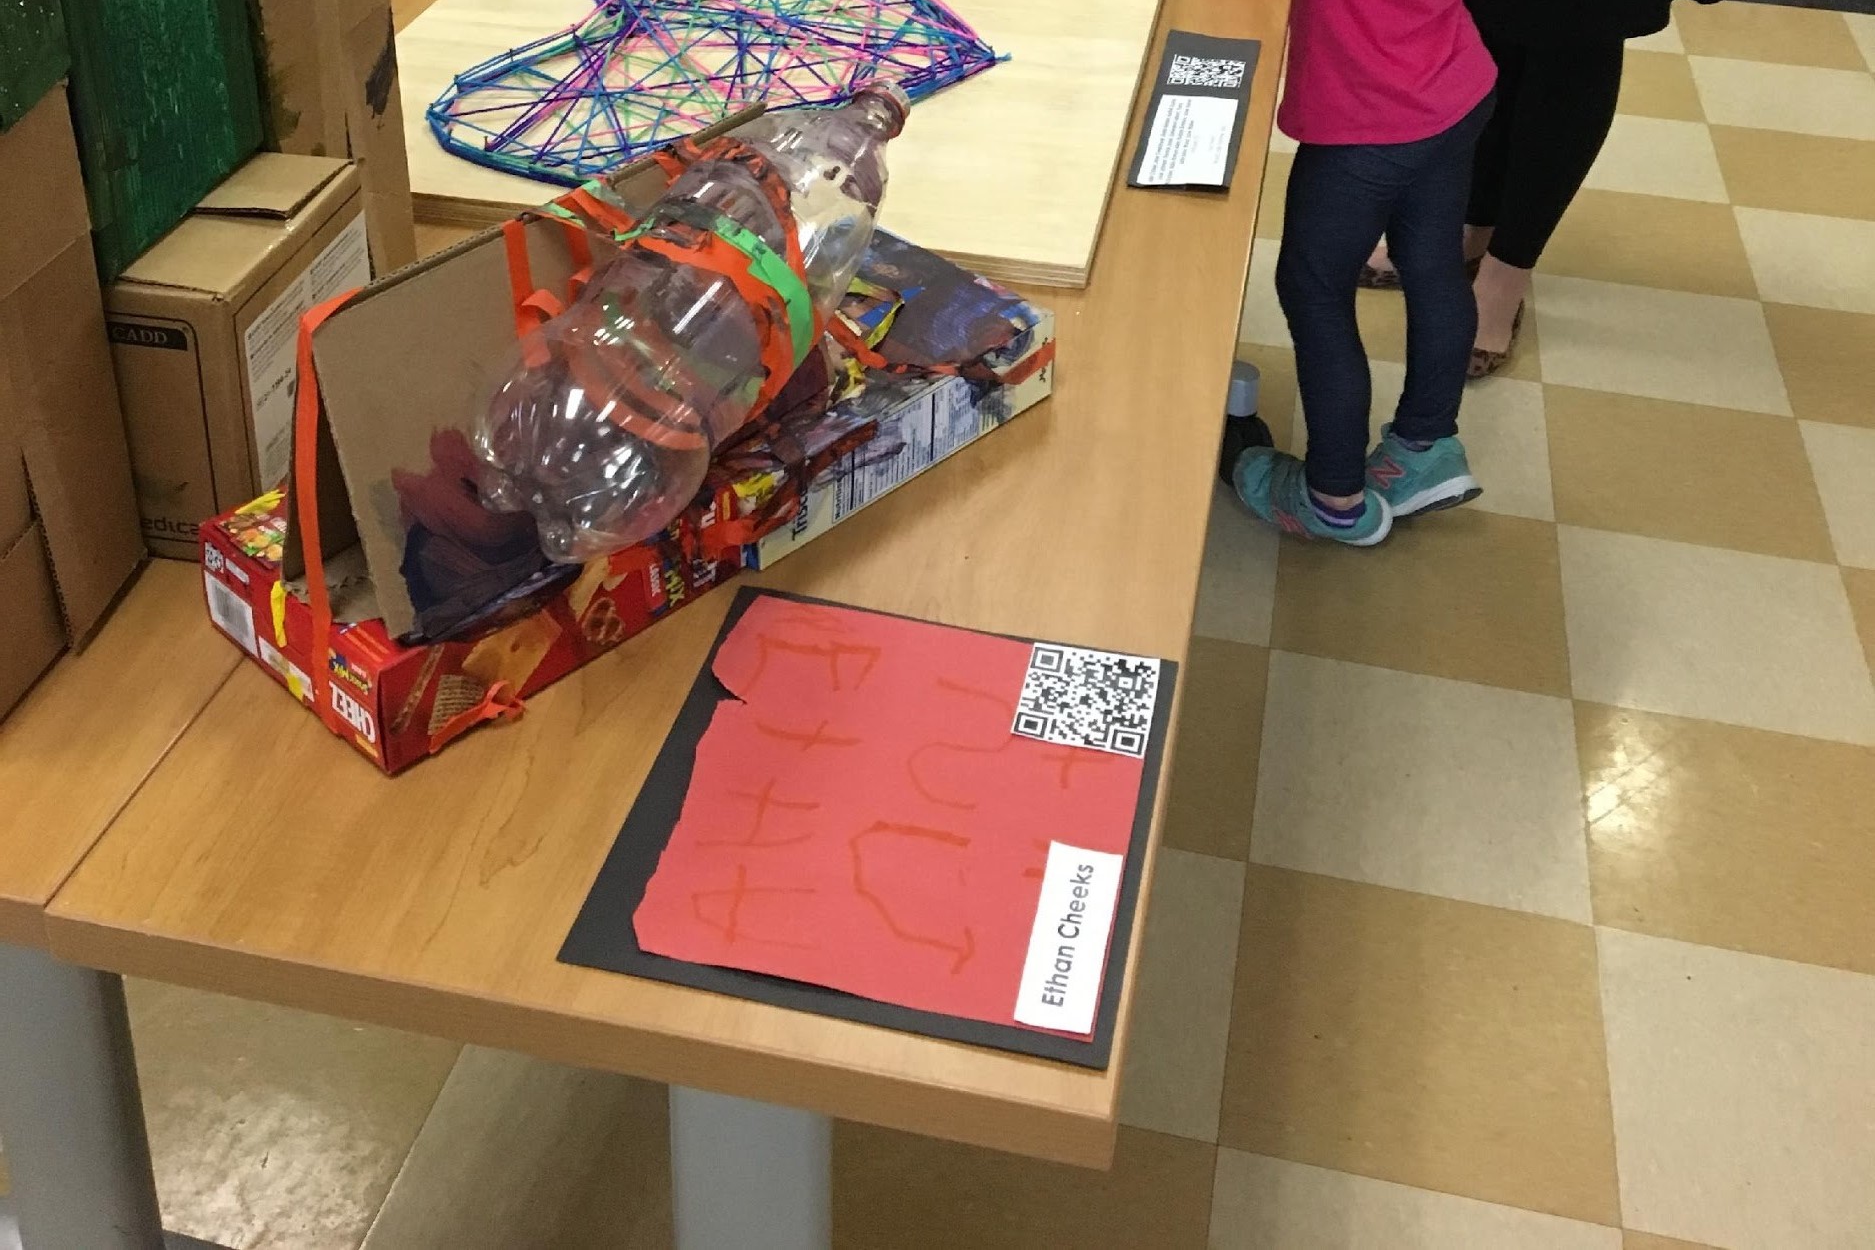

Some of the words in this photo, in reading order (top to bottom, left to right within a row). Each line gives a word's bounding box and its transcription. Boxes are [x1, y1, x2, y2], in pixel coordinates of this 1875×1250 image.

[111, 325, 169, 344] CADD
[1056, 863, 1095, 940] Cheeks
[1041, 945, 1076, 1008] Ethan
